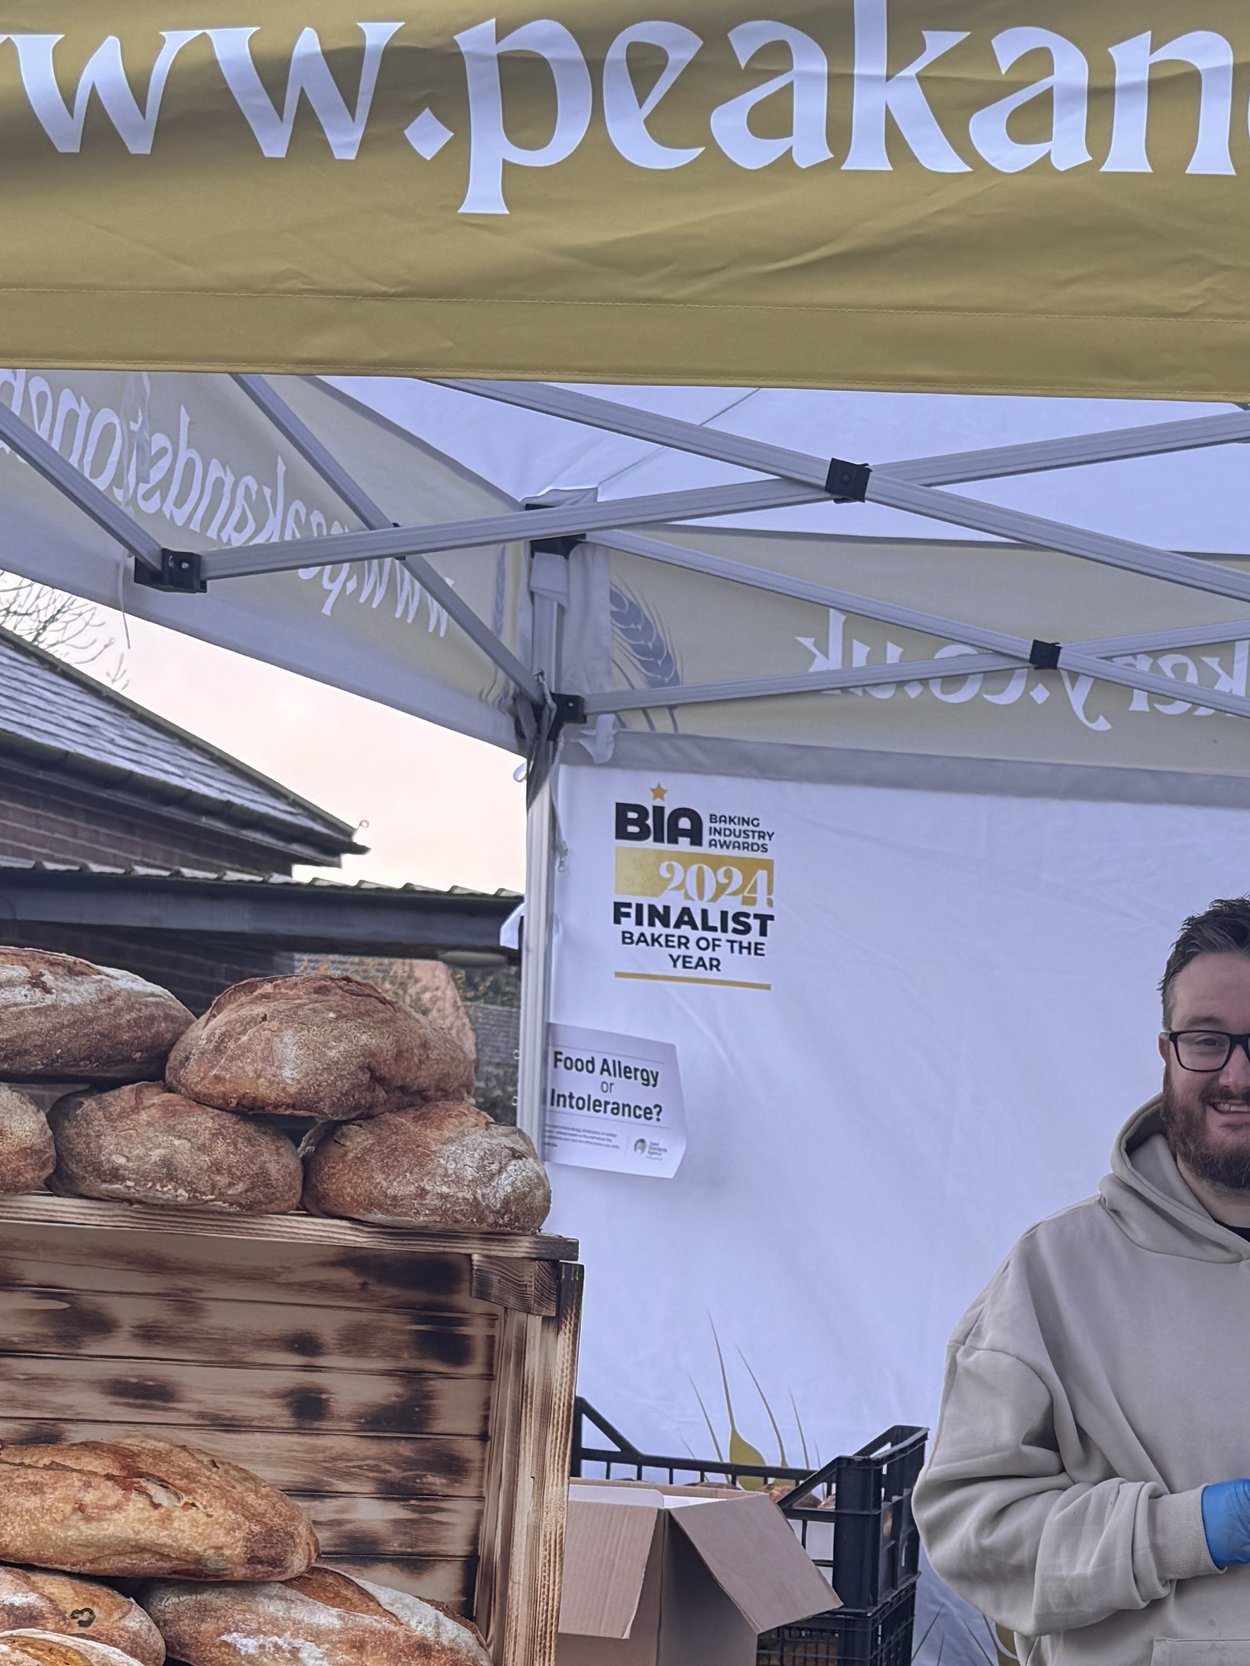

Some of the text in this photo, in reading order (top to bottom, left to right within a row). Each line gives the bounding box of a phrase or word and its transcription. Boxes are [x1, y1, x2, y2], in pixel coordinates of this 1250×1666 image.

[614, 802, 703, 847] BIA
[709, 814, 760, 828] BAKING
[709, 826, 775, 842] INDUSTRY
[709, 838, 769, 853] AWARDS
[656, 860, 774, 907] 2024
[613, 901, 775, 938] FINALIST
[621, 931, 766, 957] BAKER OF THE
[668, 953, 722, 972] YEAR
[553, 1051, 660, 1088] Food Allergy
[600, 1080, 615, 1094] or
[549, 1088, 663, 1122] Intolerance?
